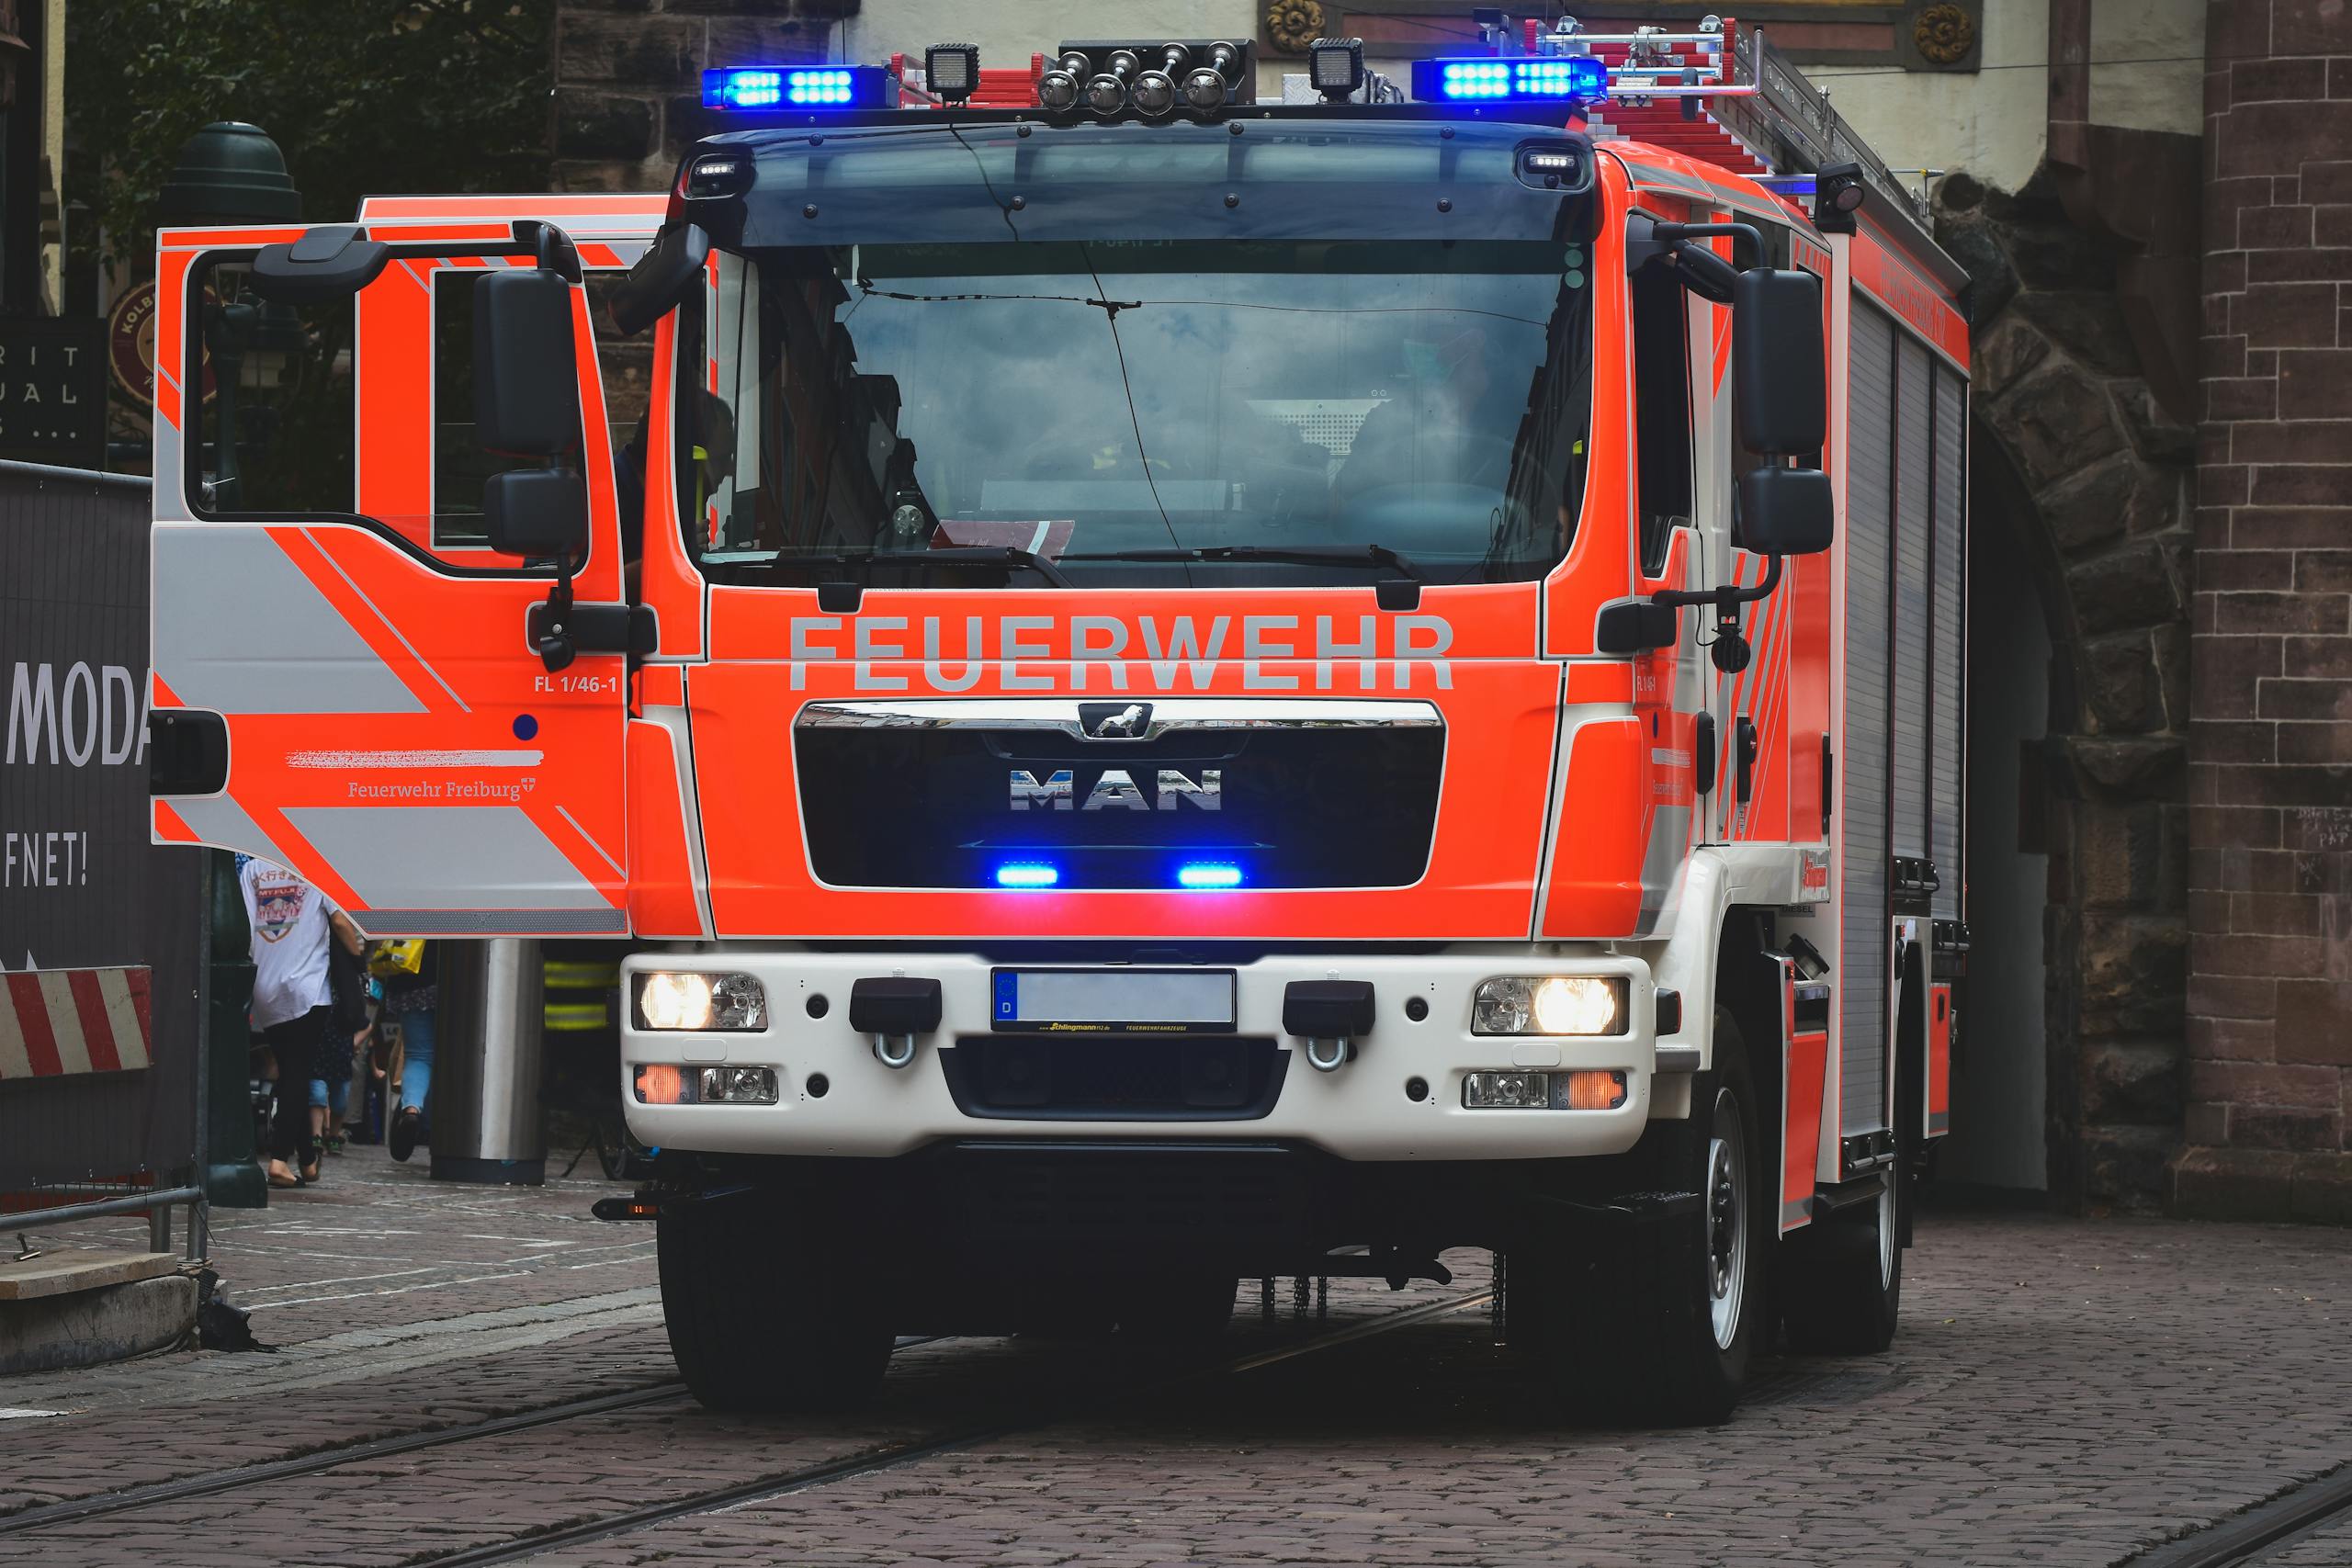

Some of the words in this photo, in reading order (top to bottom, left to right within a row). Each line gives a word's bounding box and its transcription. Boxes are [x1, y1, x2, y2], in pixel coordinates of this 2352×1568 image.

[789, 615, 1454, 692] FEUERWEHR
[535, 676, 554, 693] FL
[560, 676, 616, 693] 1/46-1
[347, 782, 441, 798] Feuerwehr
[446, 781, 520, 802] Freiburg
[1010, 769, 1222, 810] MAN
[5, 831, 87, 887] FNET!
[1002, 1002, 1011, 1013] D
